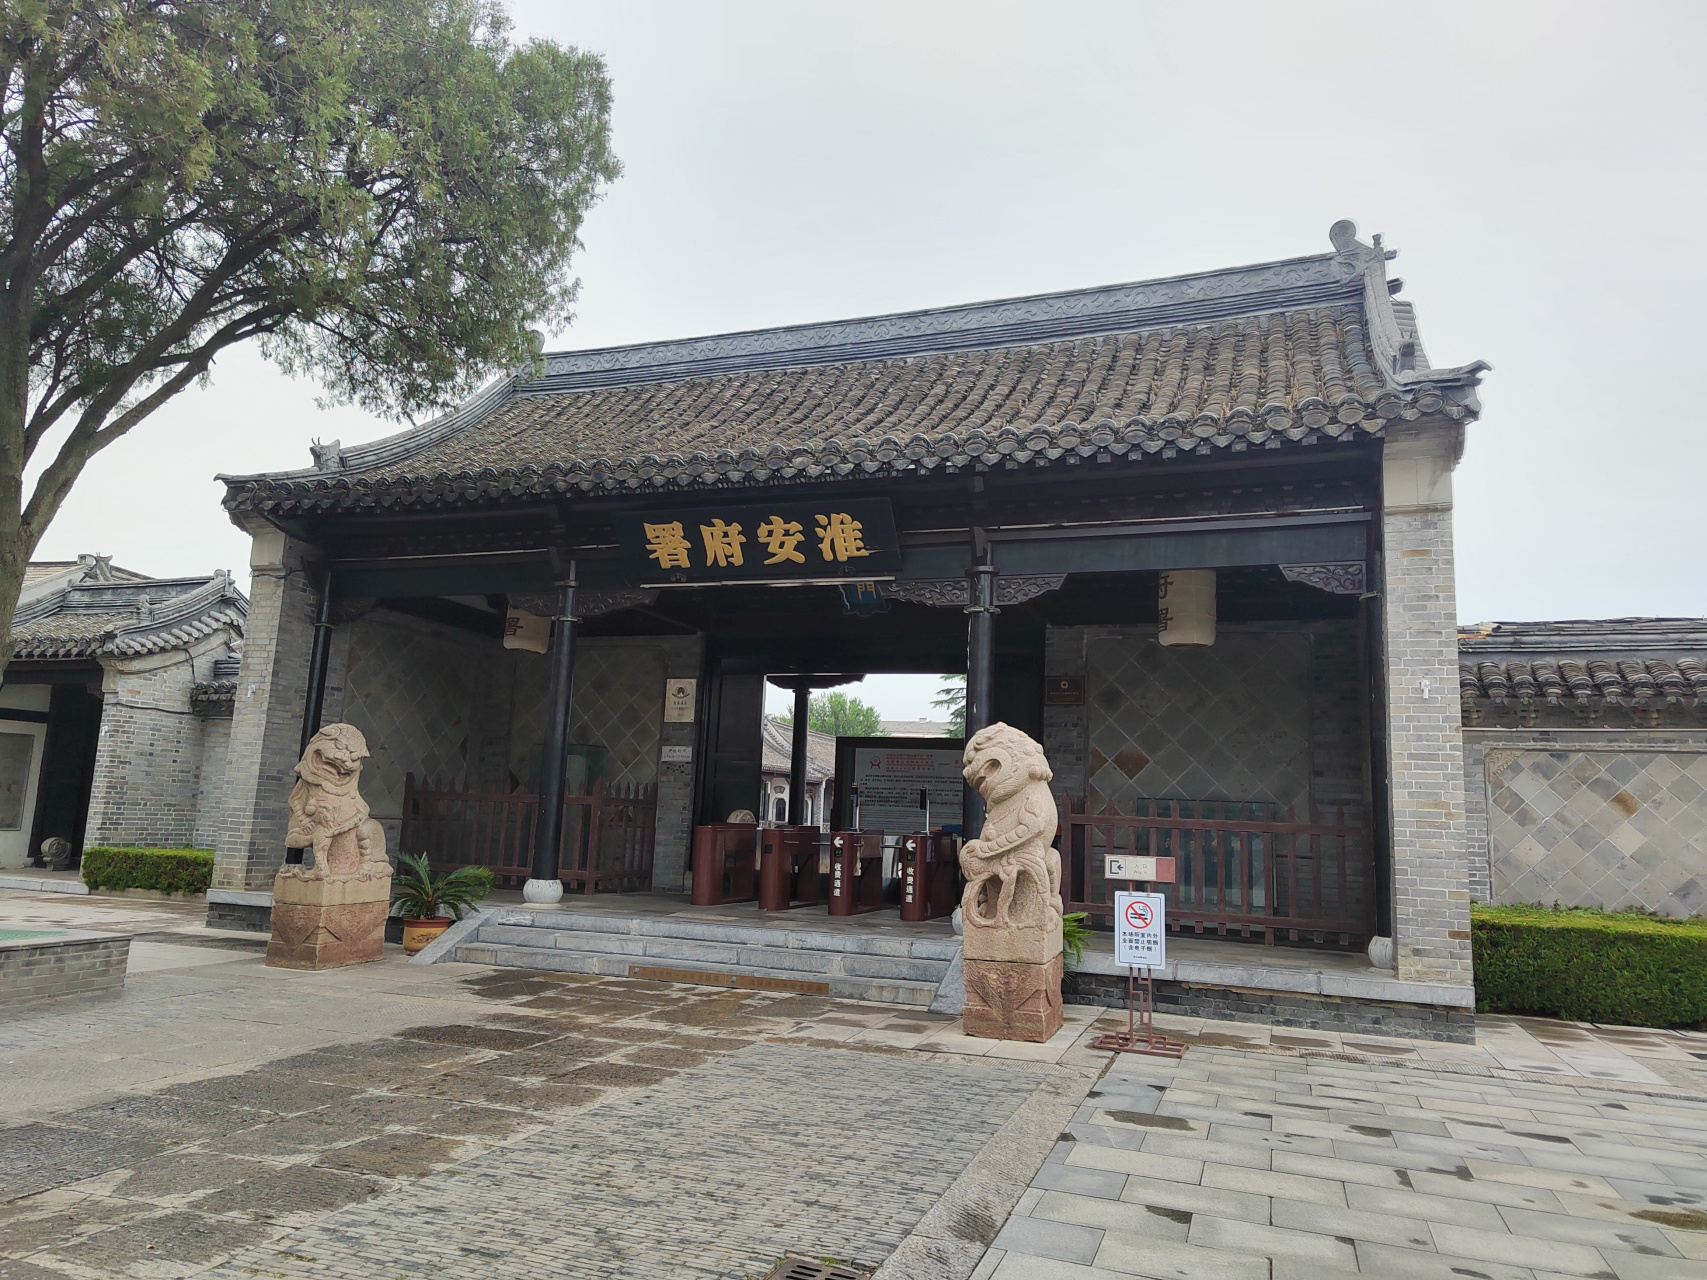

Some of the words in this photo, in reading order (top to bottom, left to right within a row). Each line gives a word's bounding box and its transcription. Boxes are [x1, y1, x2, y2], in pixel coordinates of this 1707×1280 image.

[833, 862, 842, 897] 收费通道
[905, 867, 914, 903] 收费通道
